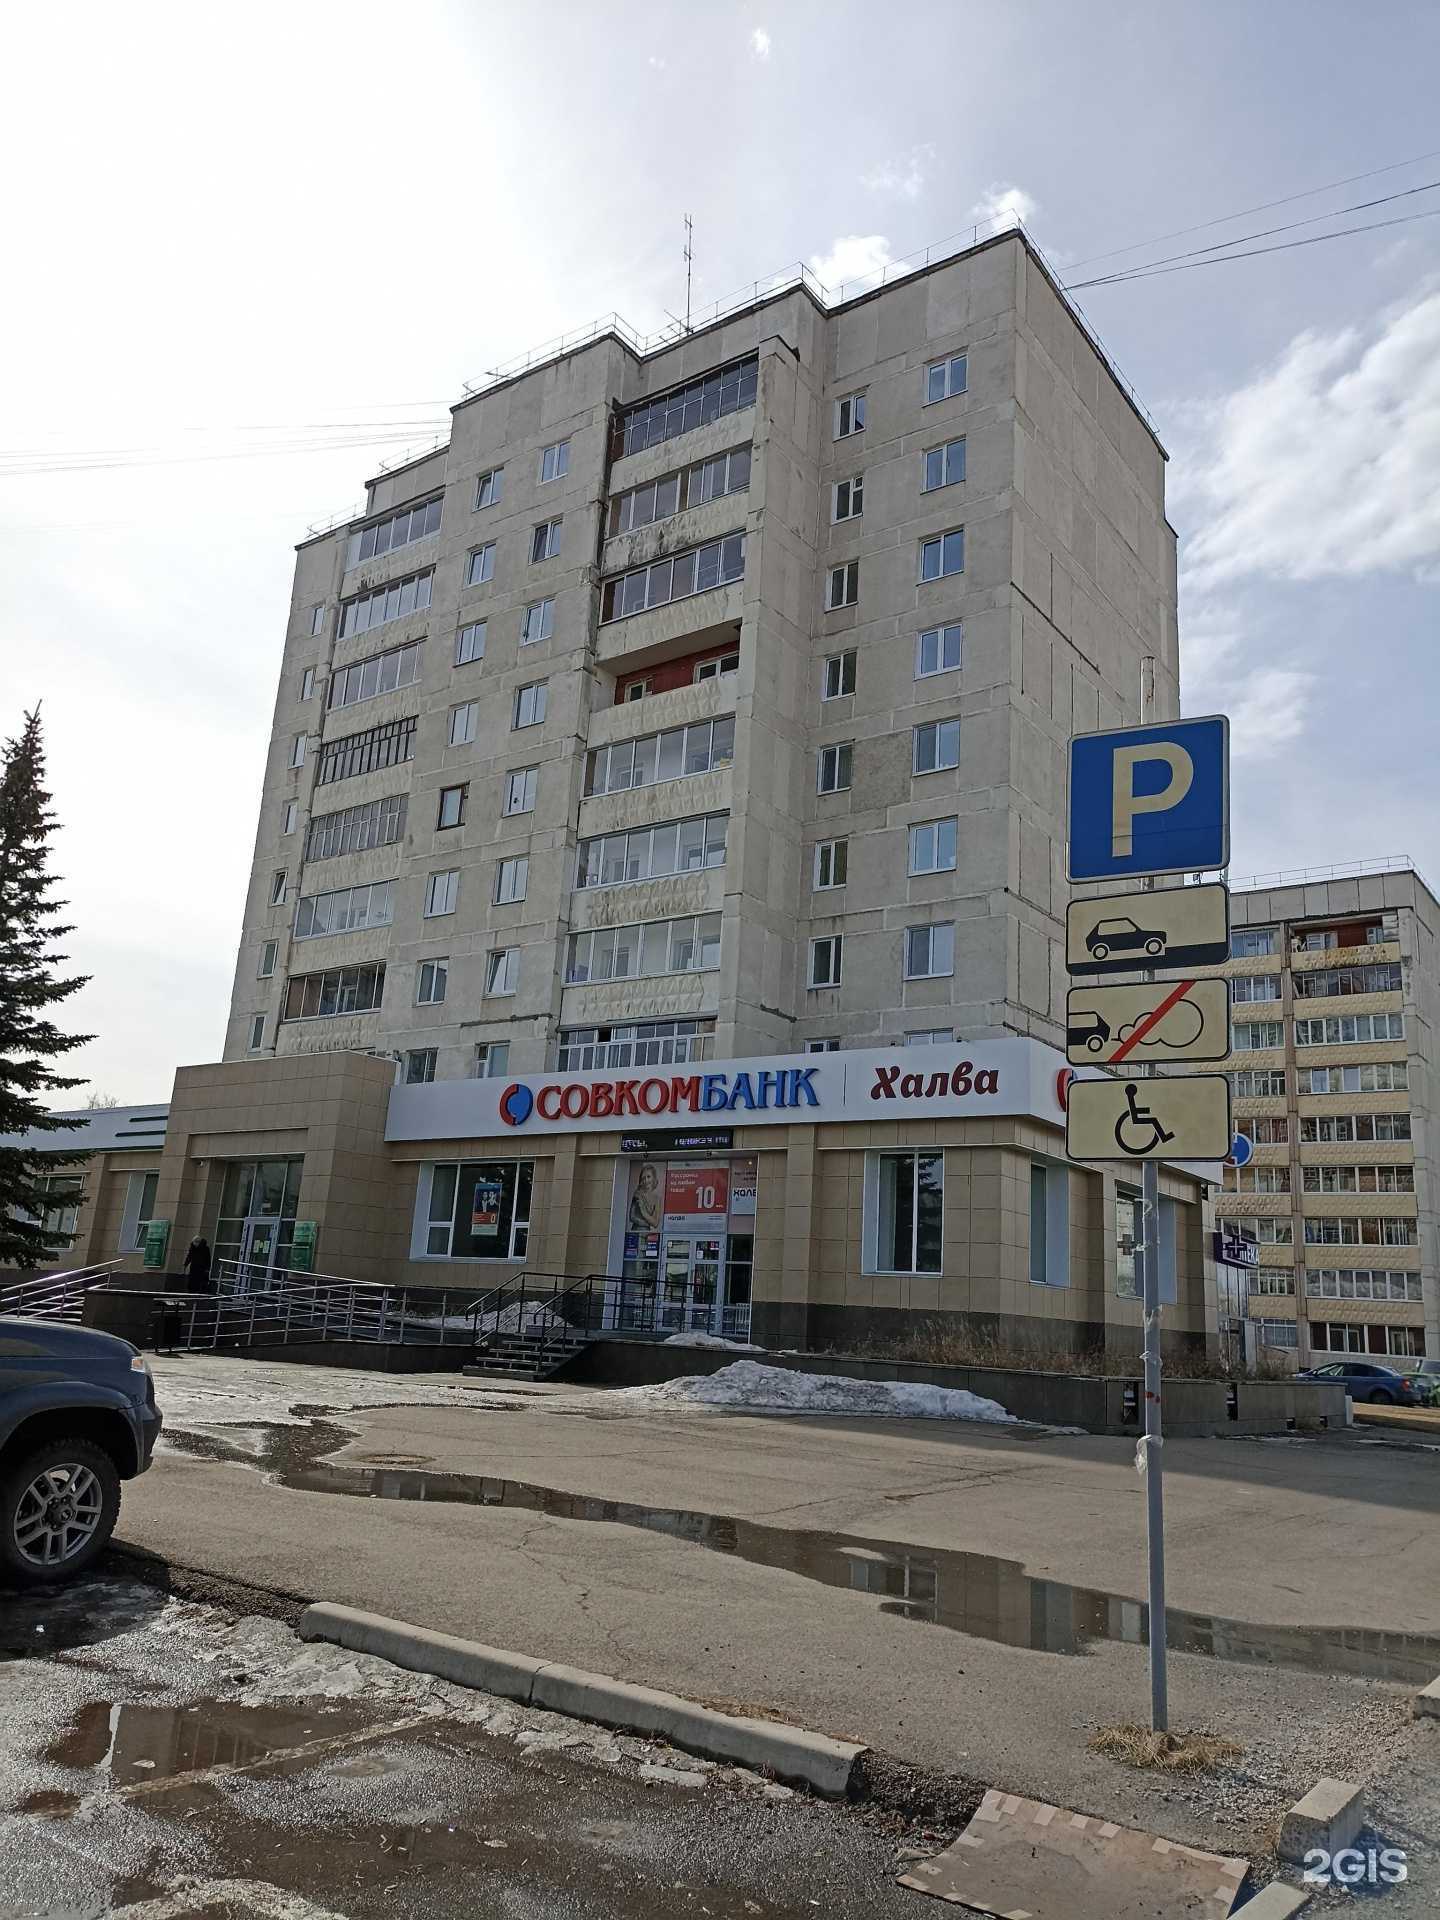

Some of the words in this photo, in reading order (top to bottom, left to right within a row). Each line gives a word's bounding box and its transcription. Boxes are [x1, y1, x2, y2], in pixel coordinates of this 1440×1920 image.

[1112, 742, 1194, 857] P
[536, 1068, 820, 1120] СОВКОМБАНК
[870, 1061, 999, 1100] Халва
[696, 1186, 715, 1208] 10
